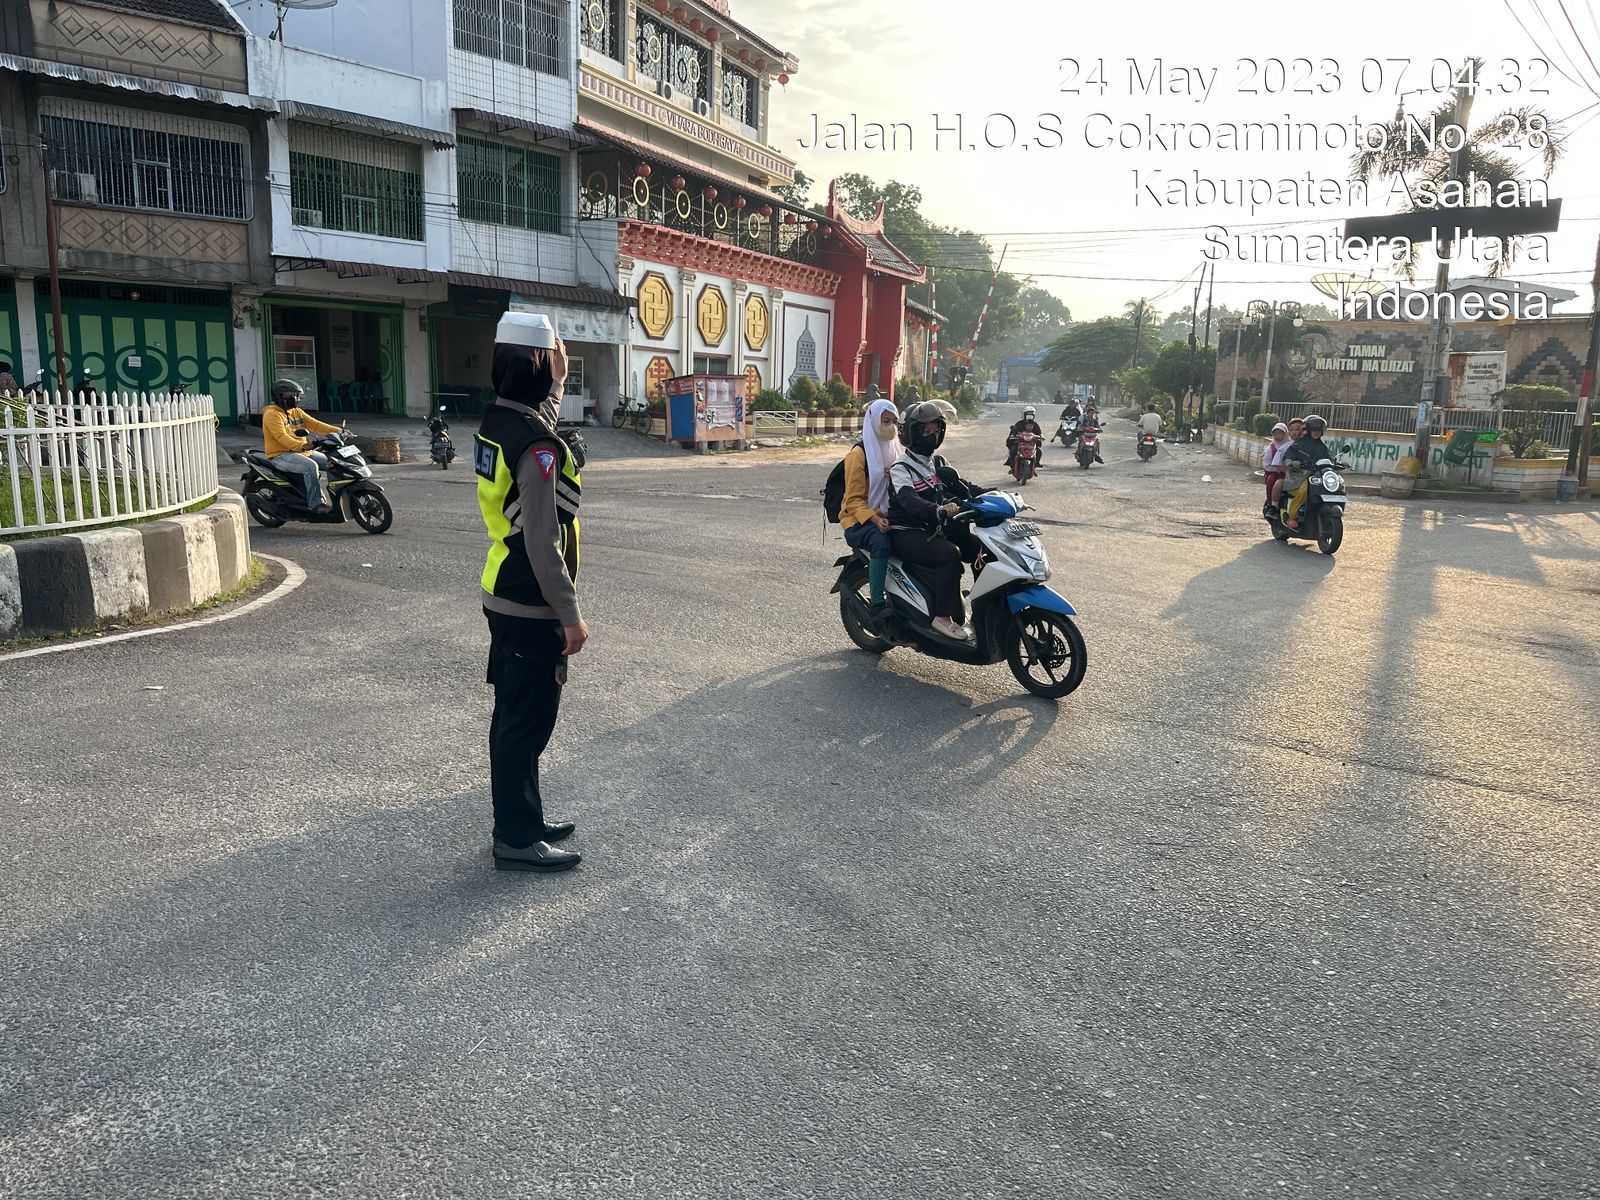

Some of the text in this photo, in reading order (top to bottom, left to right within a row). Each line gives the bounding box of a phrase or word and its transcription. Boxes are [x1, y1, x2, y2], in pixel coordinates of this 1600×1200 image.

[667, 111, 697, 136] VIHARA
[1348, 345, 1386, 358] TAMAN
[1315, 357, 1415, 373] MANTRI MA'DJIZAT
[1348, 439, 1399, 461] MANTRI
